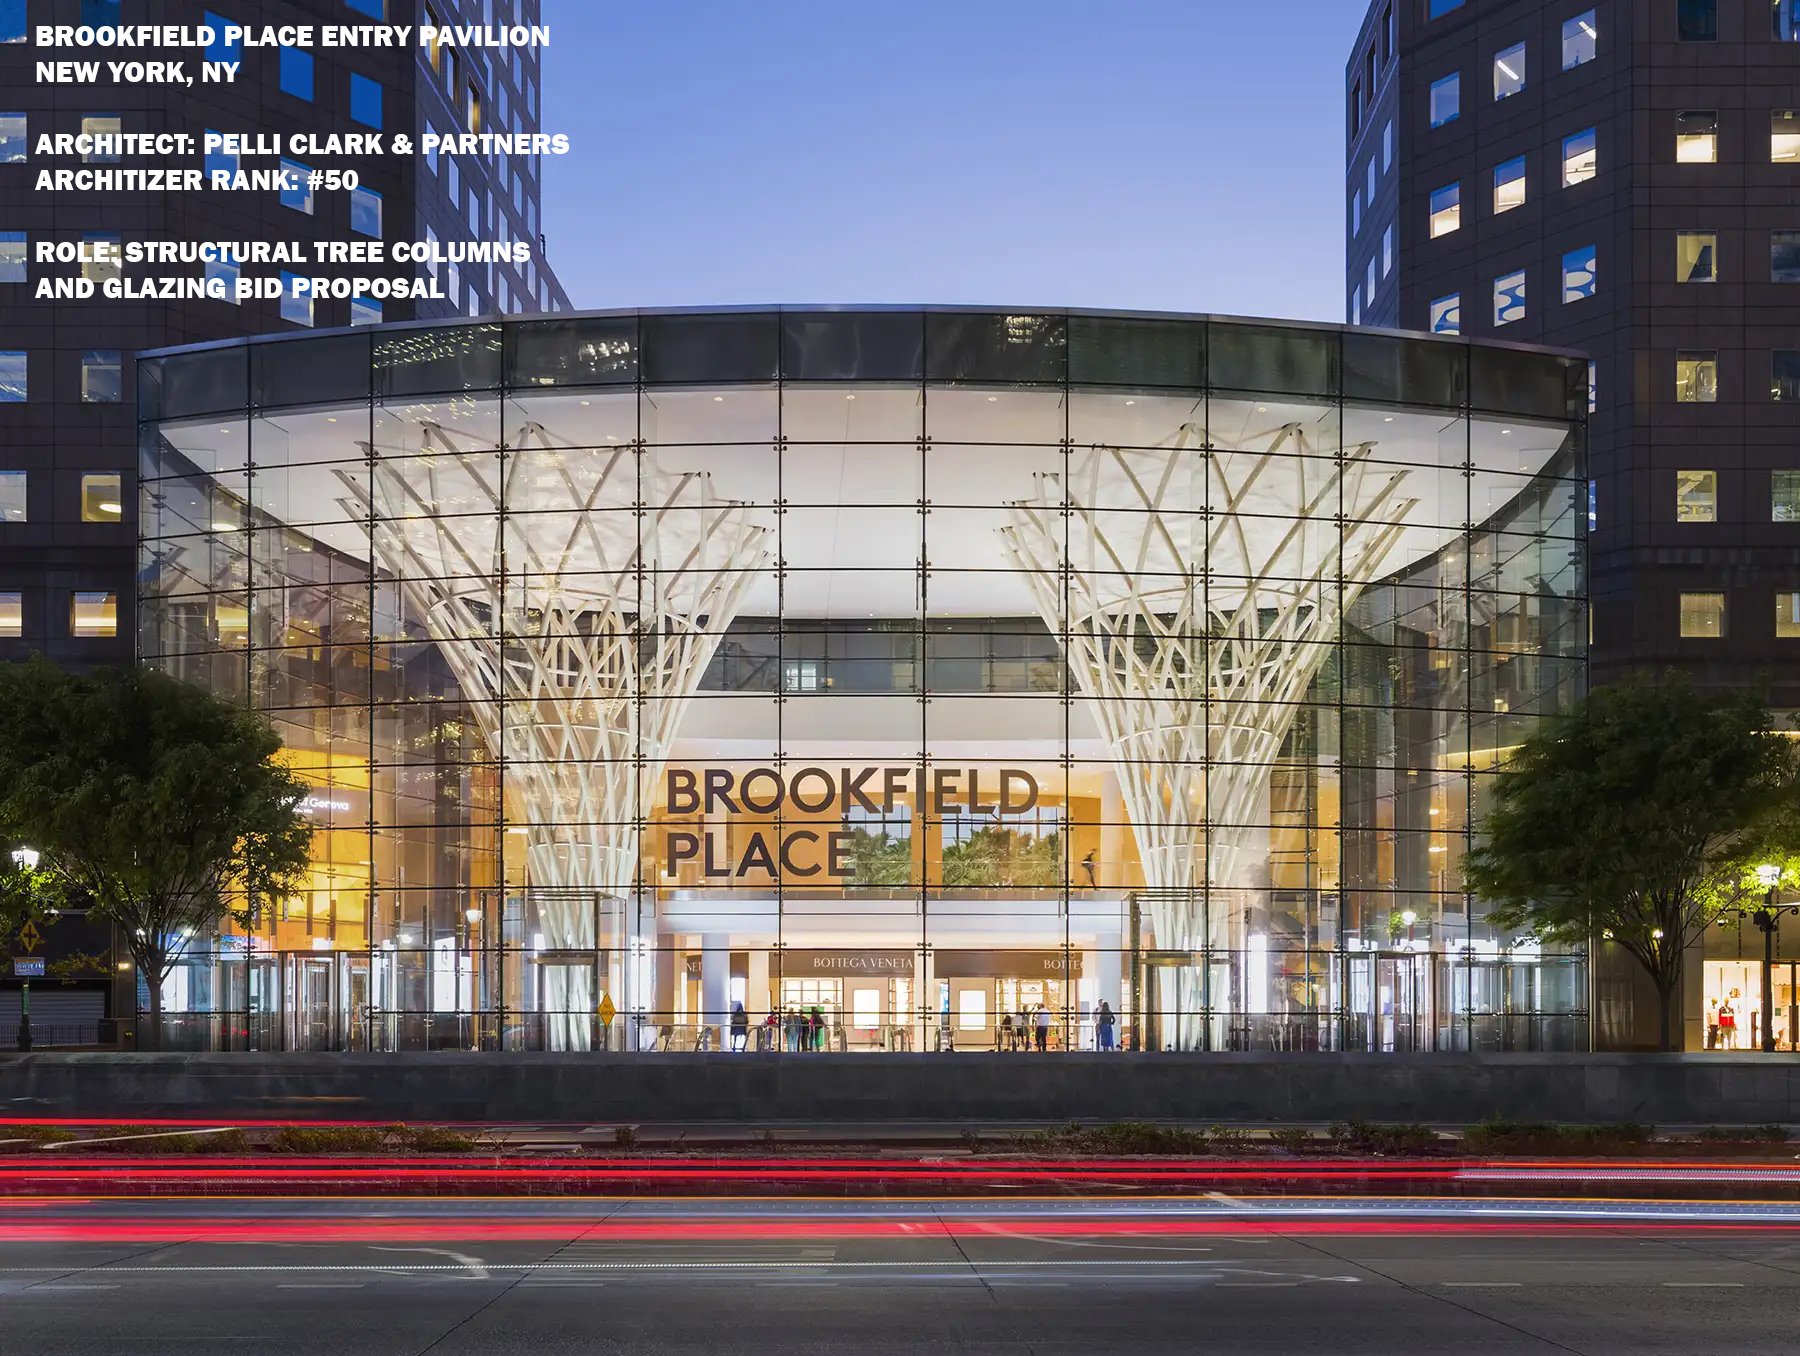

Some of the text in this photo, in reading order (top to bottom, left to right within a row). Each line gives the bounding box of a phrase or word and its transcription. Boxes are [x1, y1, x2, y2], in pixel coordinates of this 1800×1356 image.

[667, 767, 1039, 814] BROOKFIELD
[667, 830, 856, 877] PLACE
[813, 957, 914, 968] BOTTEGA VENETA
